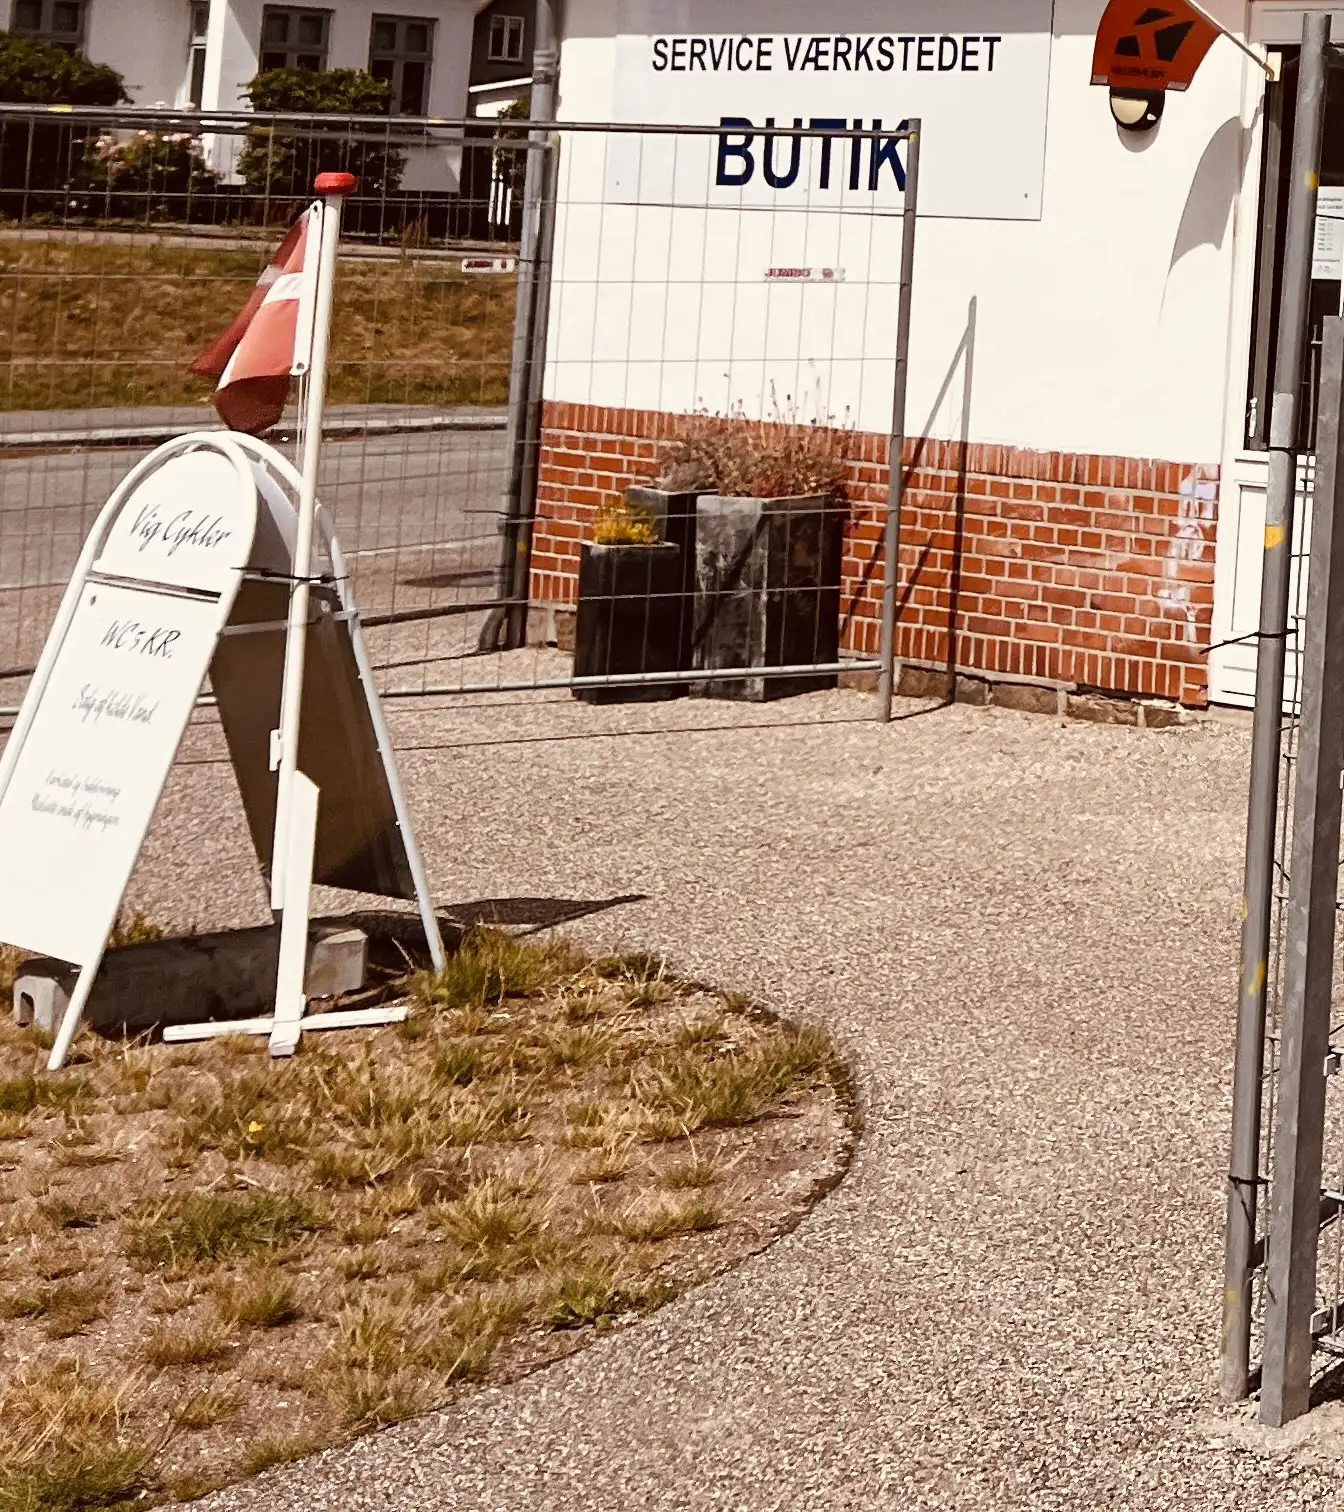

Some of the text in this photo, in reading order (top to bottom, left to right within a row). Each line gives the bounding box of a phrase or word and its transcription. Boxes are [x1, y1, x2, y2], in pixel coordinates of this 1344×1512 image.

[652, 36, 1002, 72] SERVICE VÆRKSTEDET
[715, 116, 907, 192] BUTIK
[130, 504, 233, 557] Vig Cykler
[100, 620, 140, 649] WC
